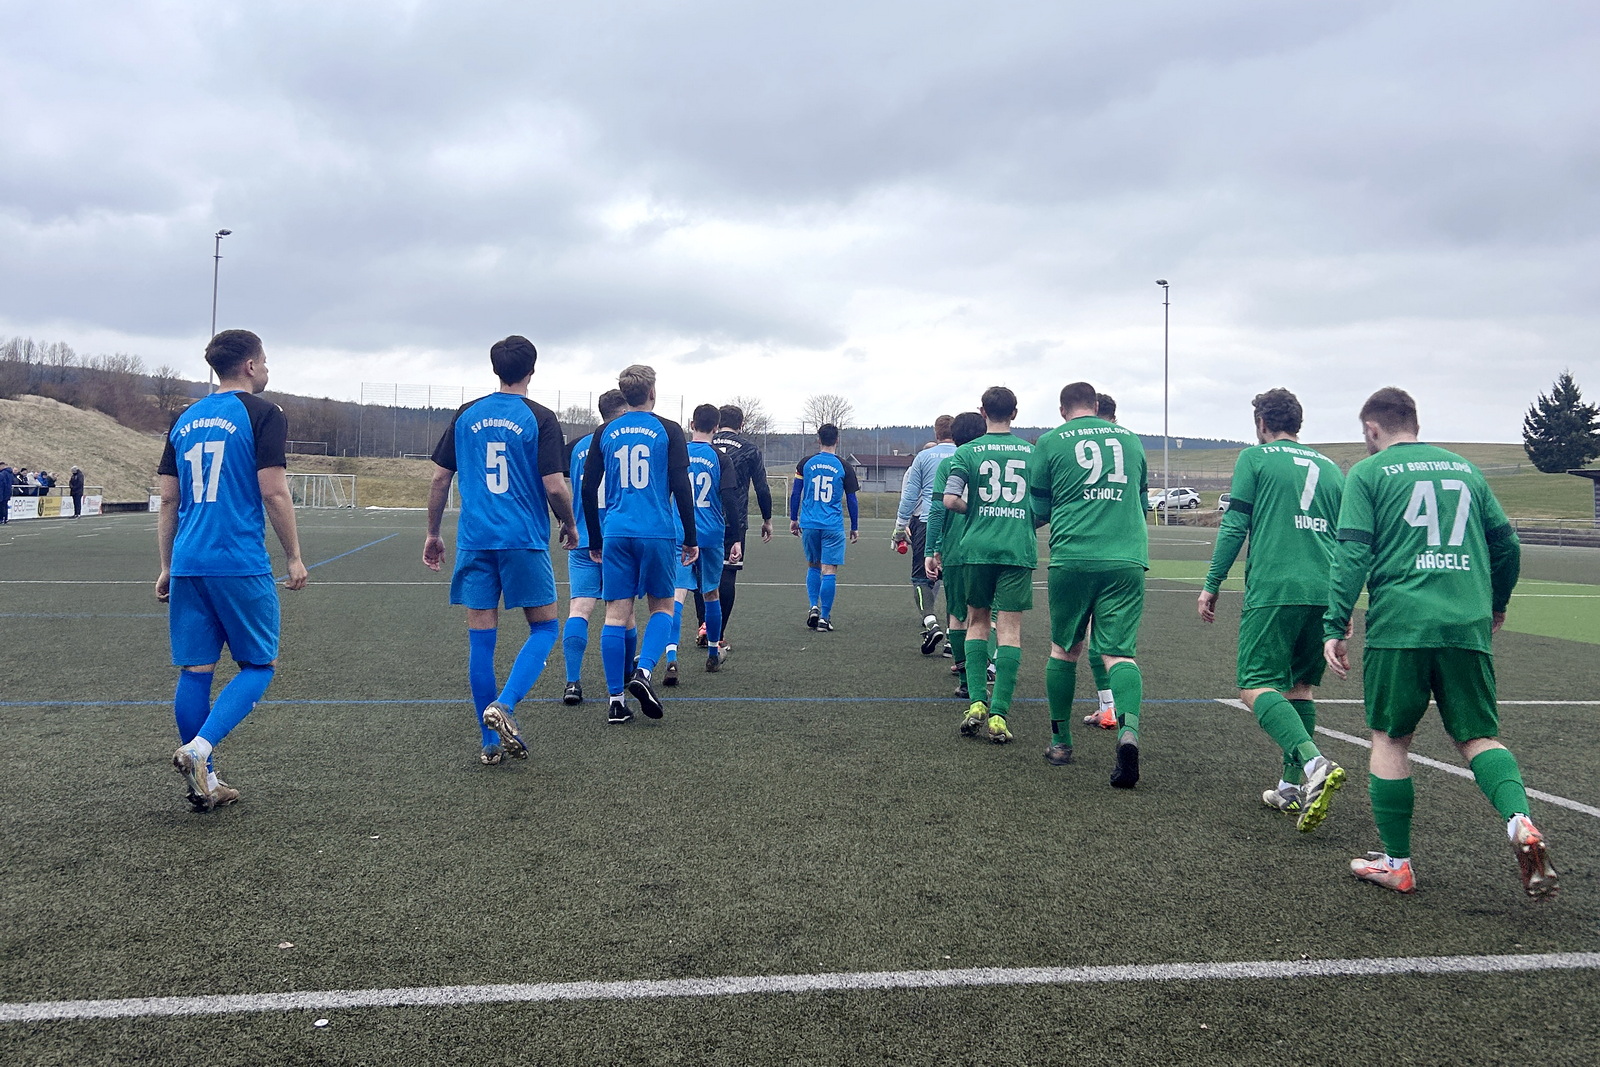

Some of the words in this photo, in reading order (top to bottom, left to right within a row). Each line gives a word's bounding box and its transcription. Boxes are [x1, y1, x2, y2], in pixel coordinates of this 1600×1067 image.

[180, 424, 191, 437] SV
[192, 416, 237, 435] Göggingen
[471, 421, 482, 434] SV
[482, 417, 523, 435] Göggingen
[610, 429, 620, 440] SV
[620, 426, 658, 439] Göggingen
[1059, 430, 1075, 439] TSV
[577, 450, 585, 460] SV
[1074, 438, 1128, 485] 91
[184, 440, 225, 504] 17
[486, 442, 509, 495] 5
[614, 443, 650, 489] 16
[1382, 463, 1404, 476] TSV
[811, 474, 834, 503] 15
[978, 459, 1027, 504] 35
[1292, 456, 1320, 511] 7
[1083, 487, 1123, 502] SCHOLZ
[978, 506, 1026, 519] PFROMMER
[1403, 479, 1472, 546] 47
[1416, 550, 1471, 571] HÄGELE
